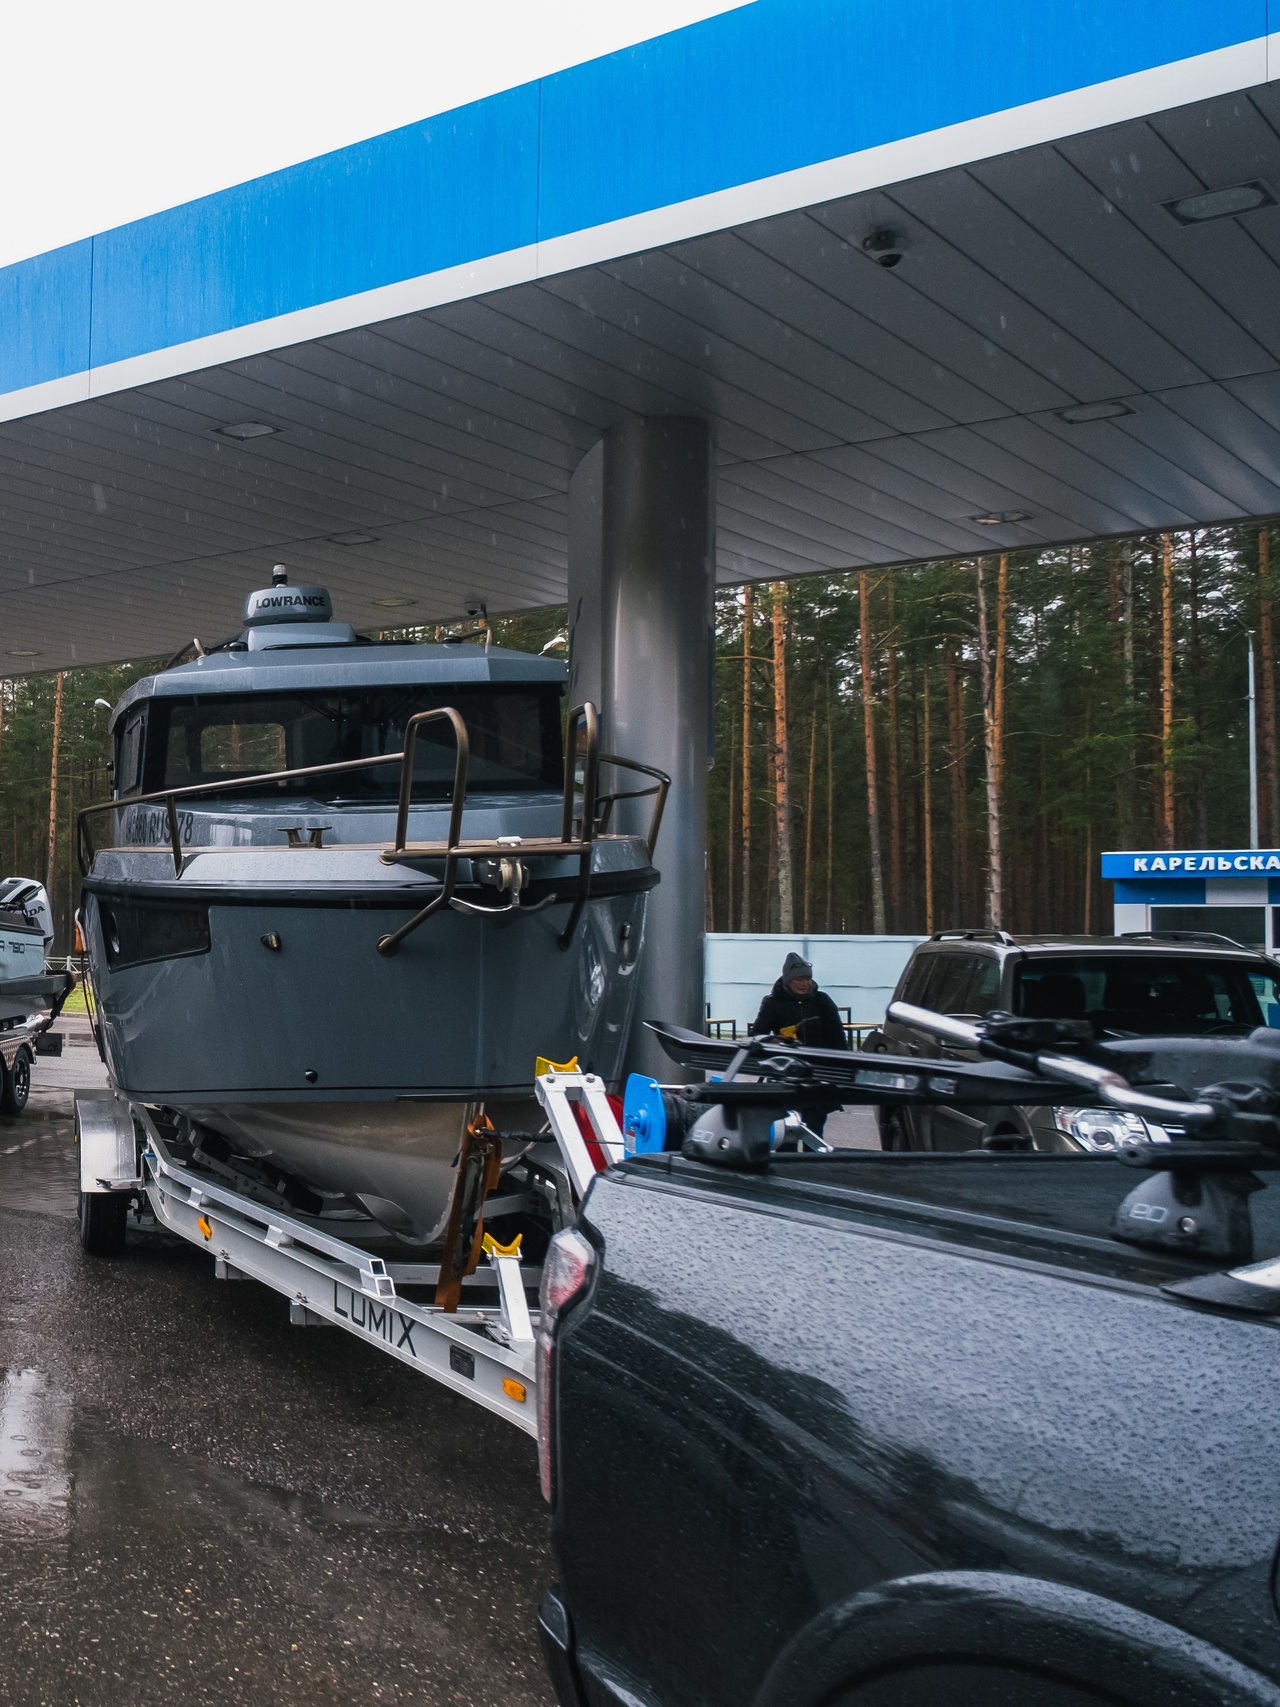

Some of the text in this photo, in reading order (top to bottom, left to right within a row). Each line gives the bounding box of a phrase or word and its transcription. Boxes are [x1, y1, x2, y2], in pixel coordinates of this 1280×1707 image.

[256, 595, 326, 609] LOWRANCE
[1133, 855, 1280, 872] КАРЕЛЬСКА
[29, 905, 45, 917] DA
[334, 1280, 418, 1358] LUMIX
